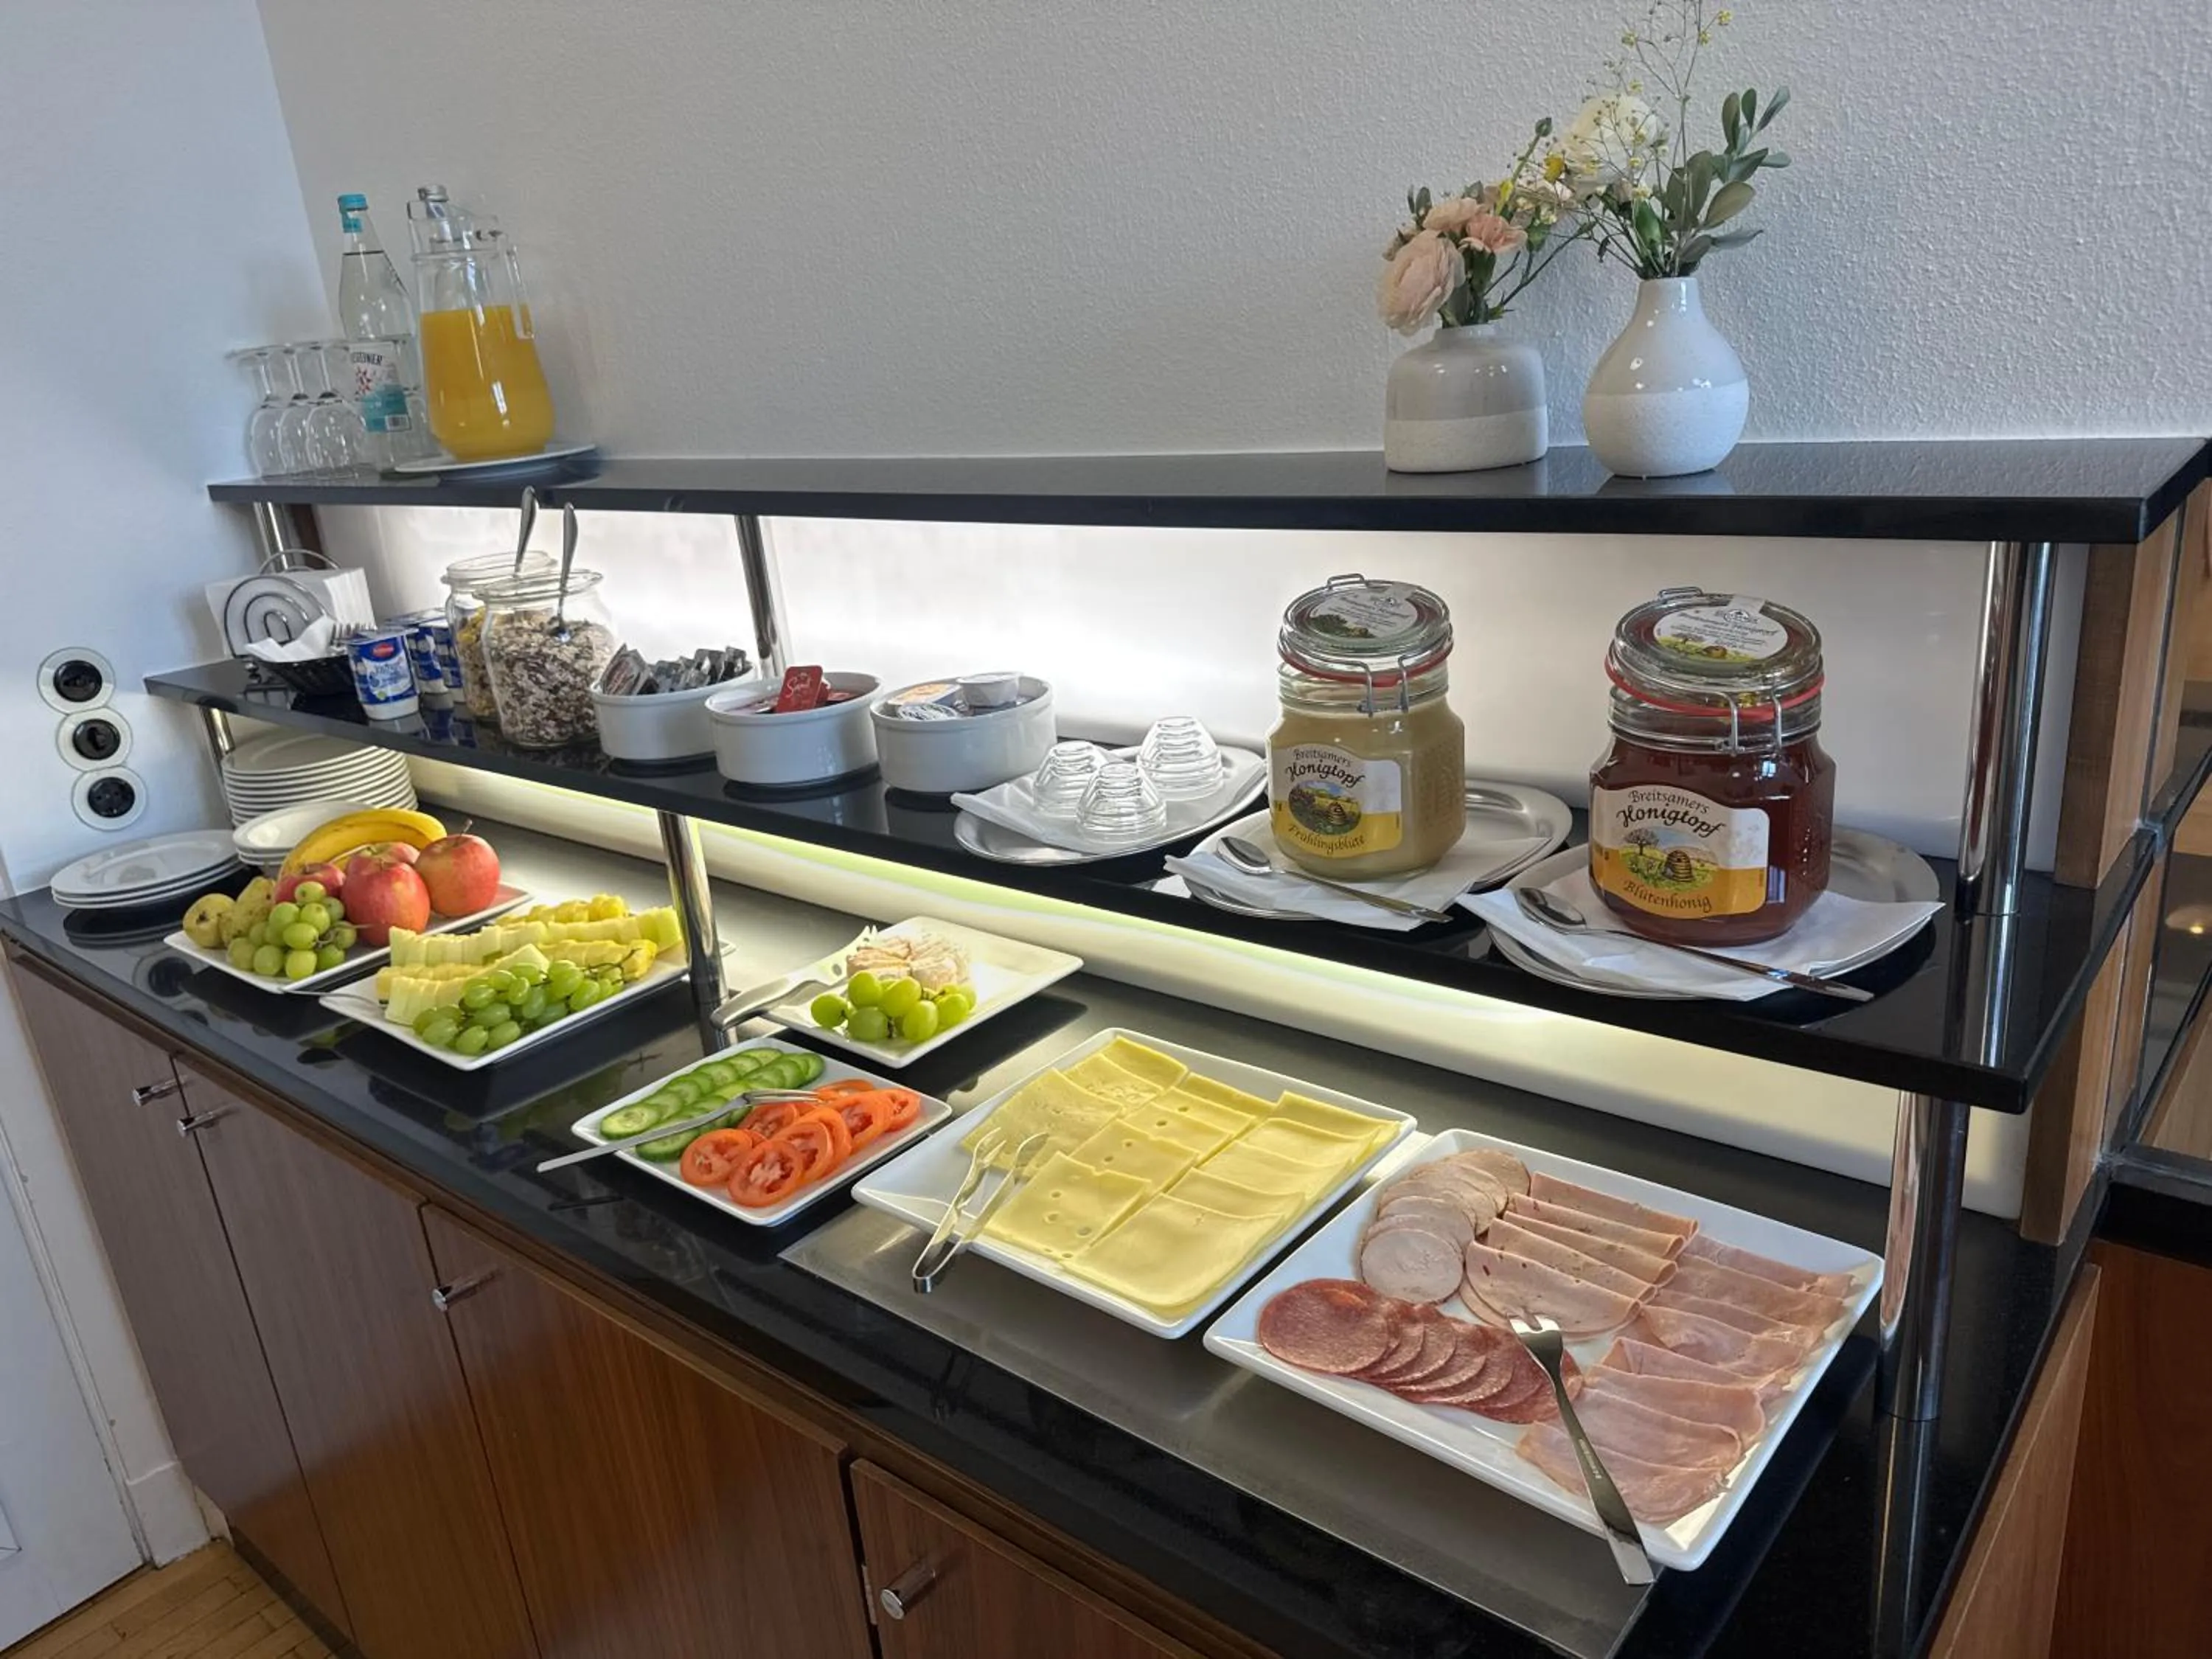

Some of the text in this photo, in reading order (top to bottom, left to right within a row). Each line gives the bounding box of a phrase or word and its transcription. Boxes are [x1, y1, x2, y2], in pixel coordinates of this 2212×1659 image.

[1293, 748, 1352, 768] Breitsamers
[1284, 759, 1366, 788] Honigtopf
[1627, 790, 1711, 814] Breitsamers
[1615, 803, 1727, 838] Honigtopf
